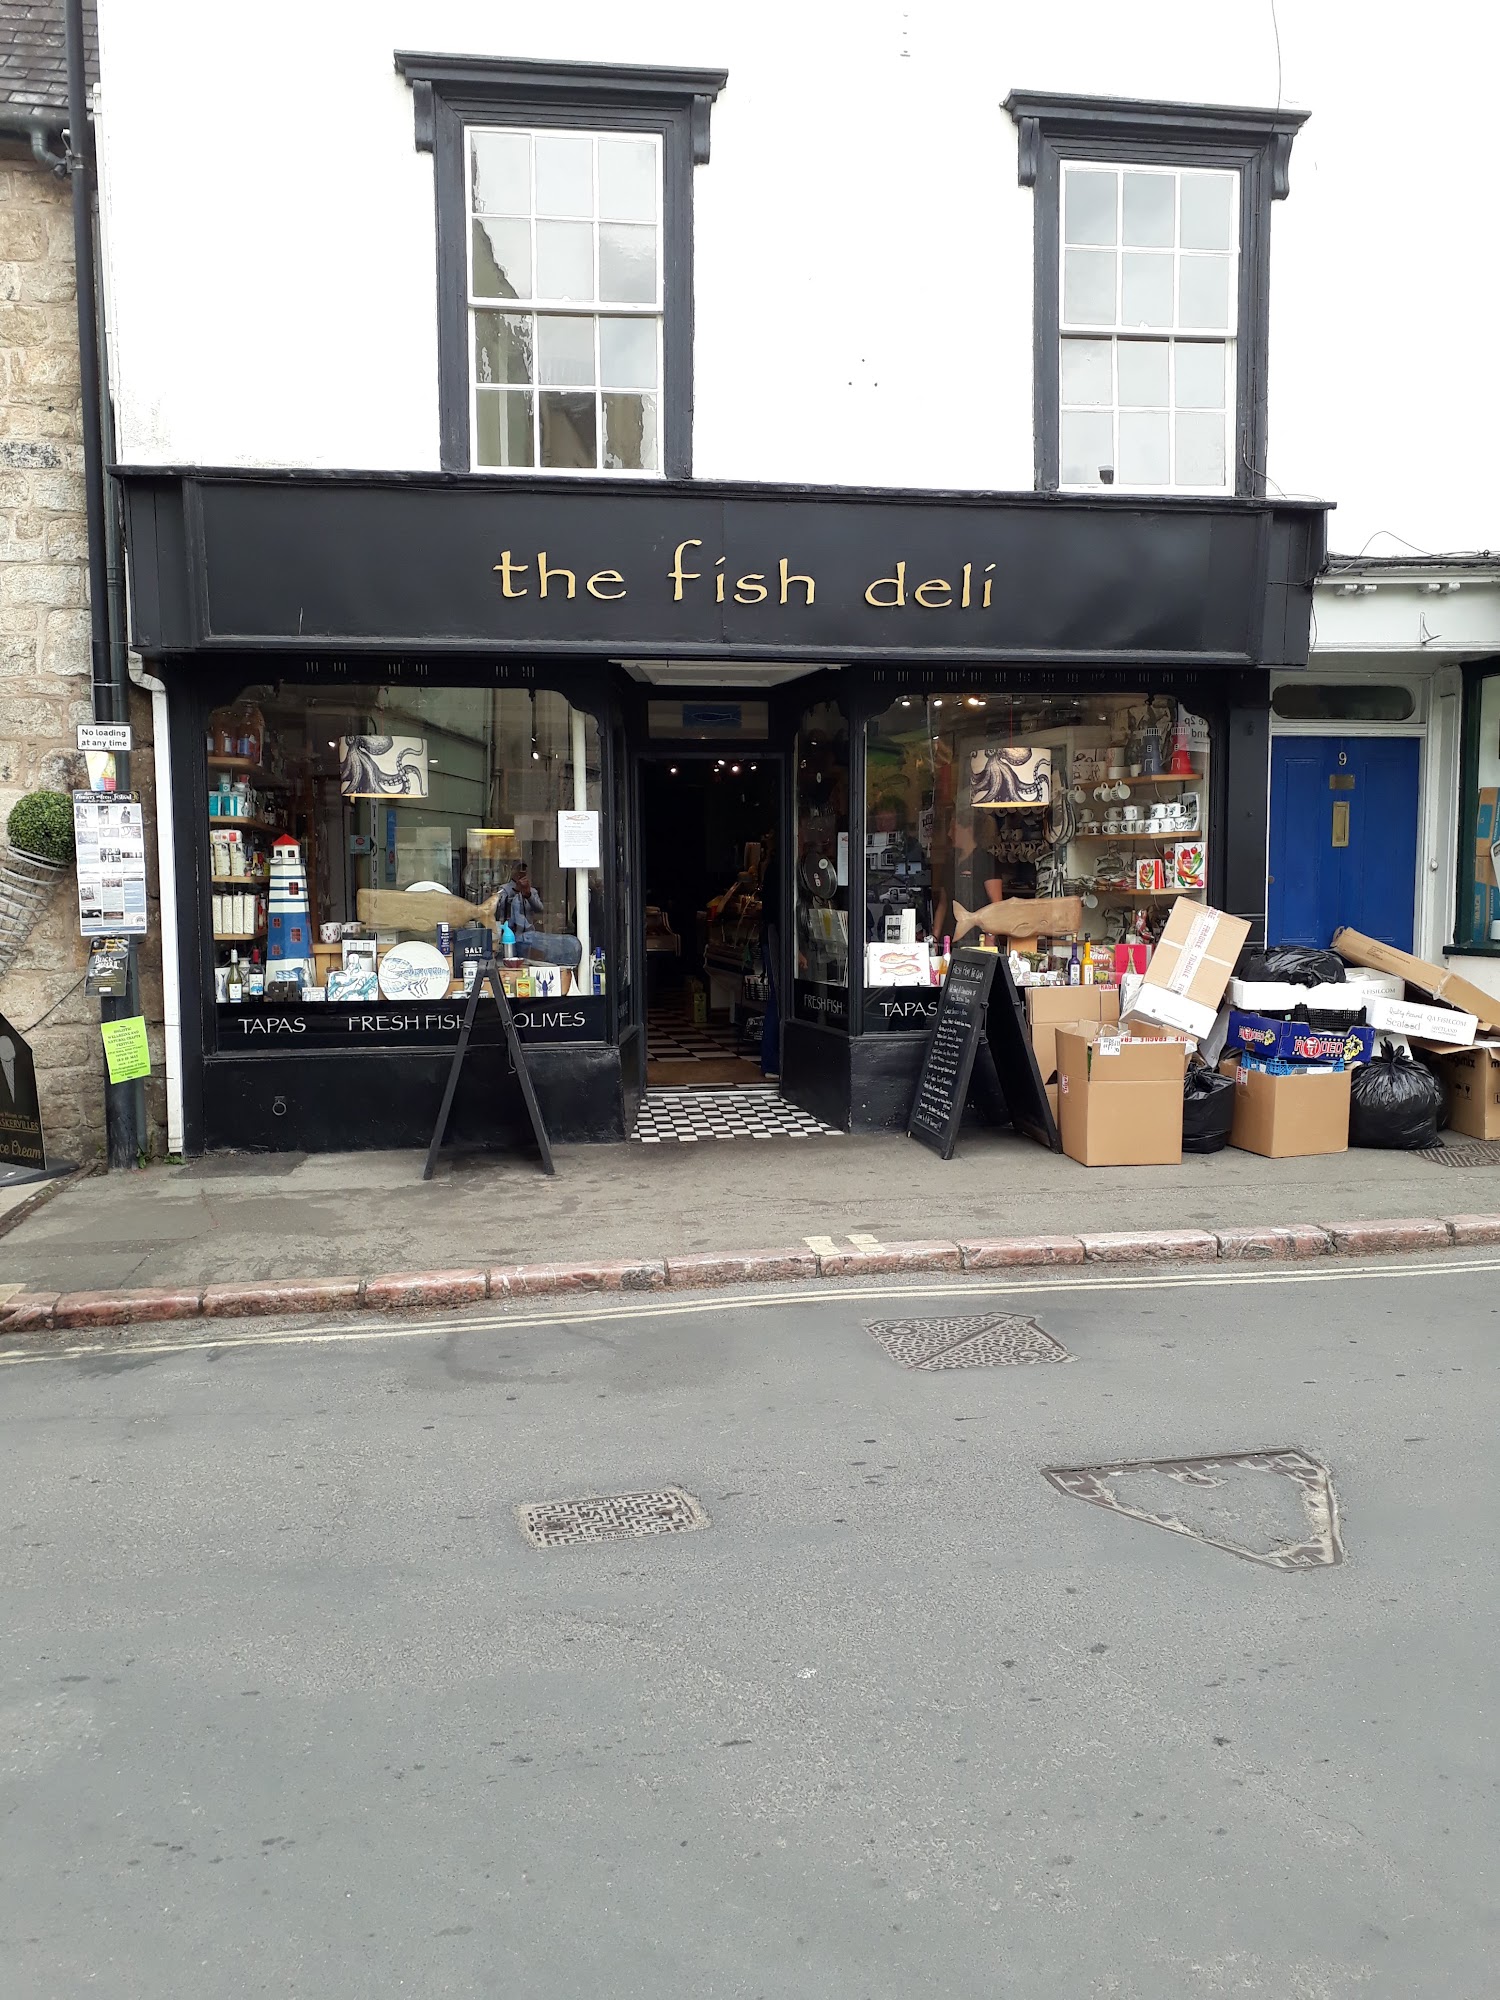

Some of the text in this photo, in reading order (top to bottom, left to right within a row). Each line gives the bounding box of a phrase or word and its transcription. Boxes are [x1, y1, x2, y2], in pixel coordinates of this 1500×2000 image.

[493, 538, 997, 608] the fish deli
[95, 729, 127, 738] loading
[109, 739, 128, 747] time
[1338, 751, 1348, 767] 9
[464, 946, 483, 954] SALT
[1090, 950, 1109, 960] aan
[804, 994, 843, 1015] FRESH FISH
[879, 1001, 939, 1017] TAPAS
[238, 1017, 307, 1034] TAPAS
[348, 1014, 465, 1031] FRESH FISH
[512, 1011, 586, 1028] OLIVES
[1385, 1017, 1421, 1031] Seafood
[11, 1139, 43, 1160] Cream
